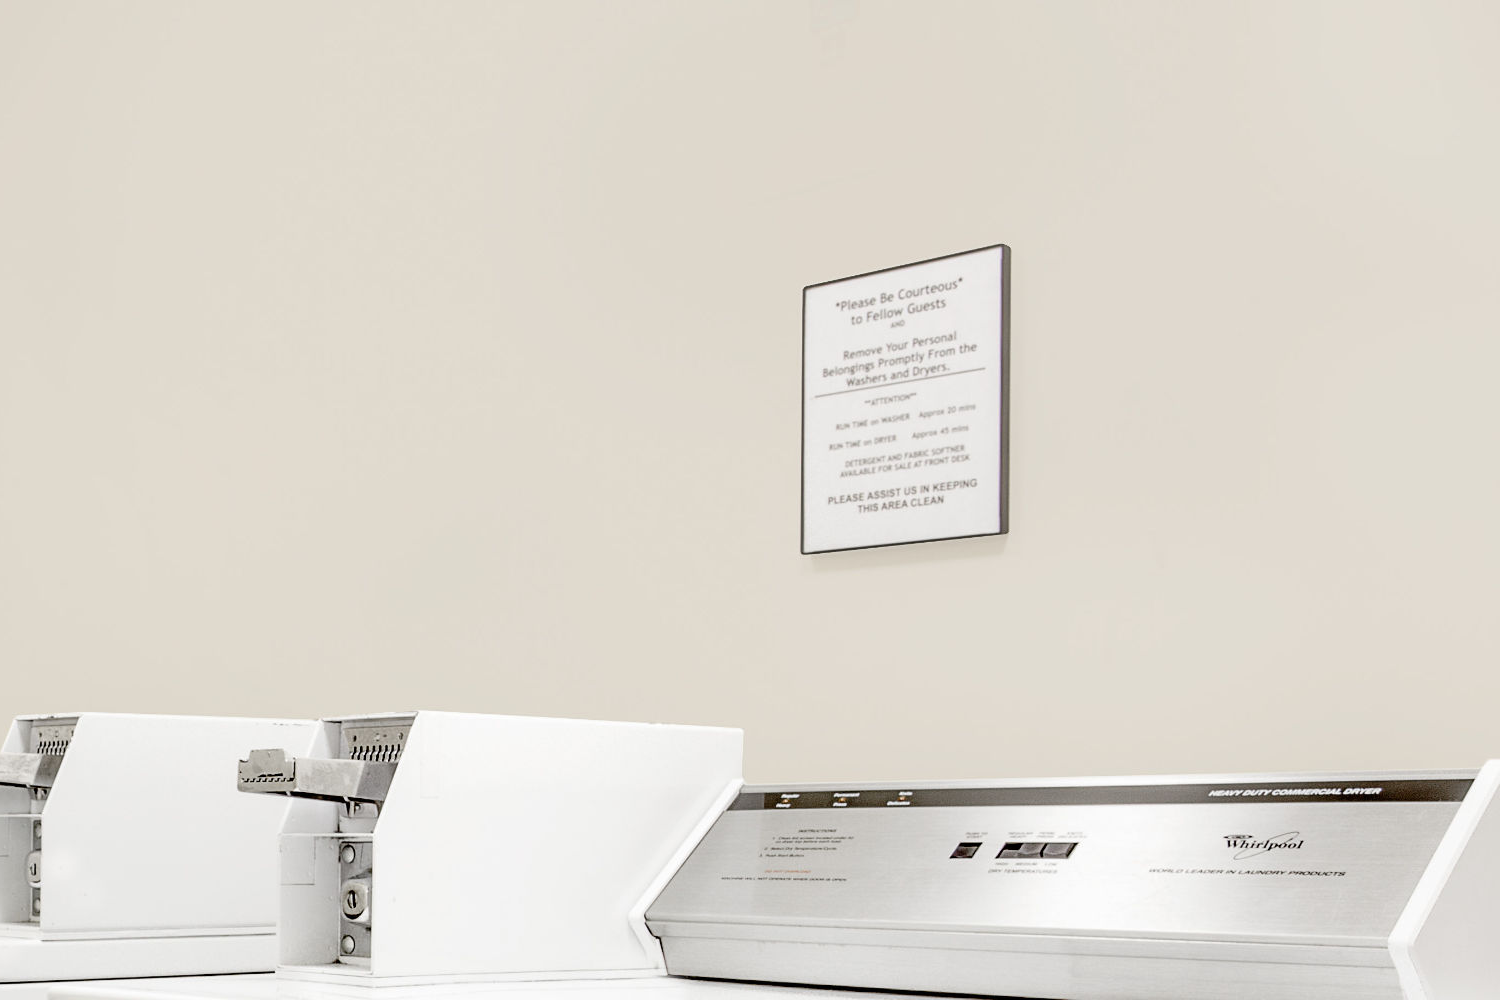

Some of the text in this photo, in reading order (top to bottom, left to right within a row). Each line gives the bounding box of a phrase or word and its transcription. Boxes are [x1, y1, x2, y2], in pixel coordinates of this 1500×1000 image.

[880, 292, 894, 304] Be
[851, 299, 946, 325] to Fellow Guests
[890, 320, 905, 328] AND
[844, 331, 957, 360] Remove Your Personal
[823, 343, 977, 378] Belongings Promptly From the
[847, 364, 950, 387] Washers and Dryers.
[840, 454, 970, 478] AVAILABLE FOR SALE AT FRONT DESK
[845, 456, 886, 468] DETERGENT
[888, 453, 901, 461] AND
[904, 451, 928, 459] FABRIC
[828, 479, 978, 505] PLEASE ASSIST US IN KEEPING
[858, 496, 944, 513] THIS AREA CLEAN
[1271, 788, 1342, 796] COMMERCIAL
[1226, 840, 1304, 851] Whirlpool
